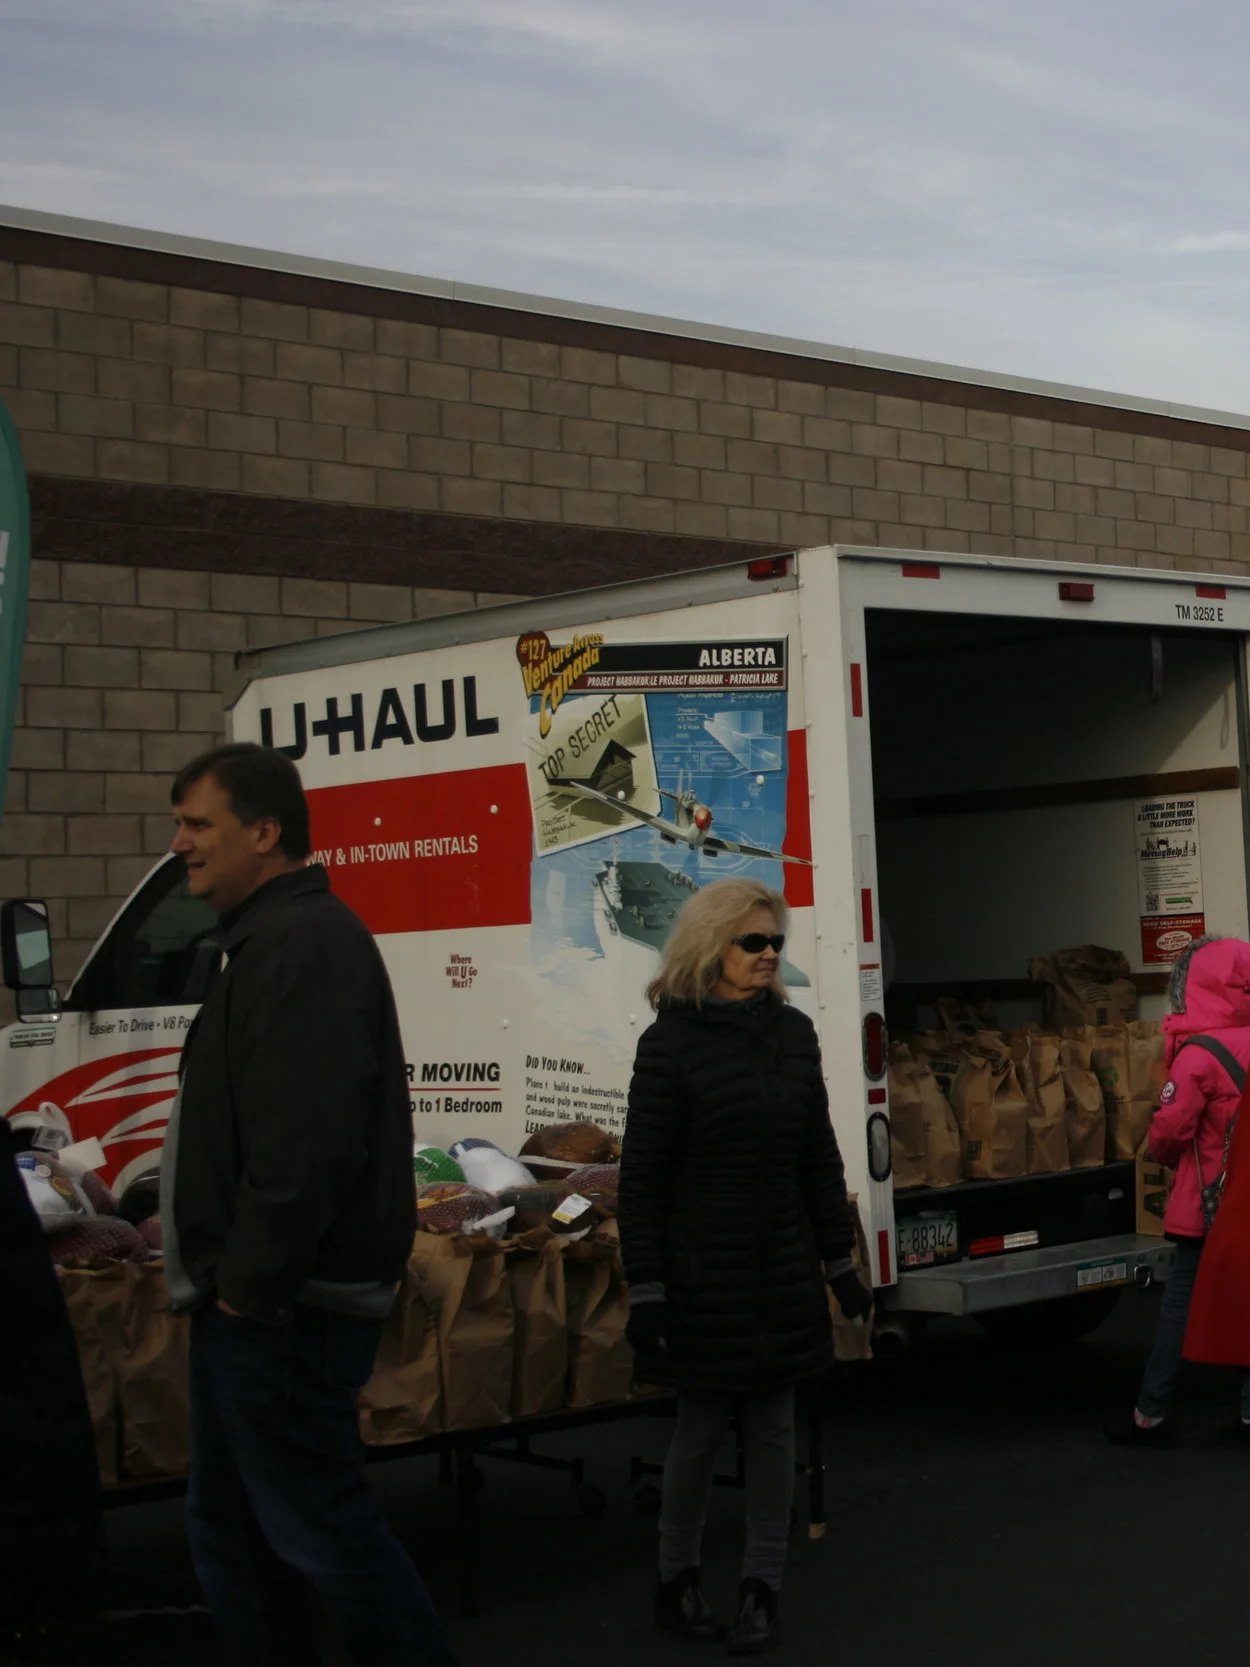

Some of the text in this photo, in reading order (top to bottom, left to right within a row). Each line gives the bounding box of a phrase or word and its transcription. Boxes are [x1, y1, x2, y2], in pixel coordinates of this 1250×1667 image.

[1175, 604, 1224, 622] TM 3252 E
[520, 639, 548, 661] #127
[699, 647, 777, 668] ALBERTA
[521, 643, 573, 699] Venture
[587, 675, 615, 688] PROJECT
[658, 674, 688, 686] PROJECT
[730, 673, 760, 685] PATRICIA
[761, 672, 778, 684] LAKE
[539, 646, 600, 739] Canada
[538, 747, 567, 782] TOP
[568, 694, 622, 759] SECRET
[1142, 812, 1160, 821] LITTLE
[1160, 810, 1176, 819] MORE
[1177, 809, 1194, 817] WORK
[1165, 802, 1176, 810] THE
[1177, 800, 1195, 809] TRUCK
[1149, 818, 1196, 829] THAN EXPECTED?
[336, 848, 346, 866] &
[350, 841, 411, 864] IN-TOWN
[414, 834, 479, 858] RENTALS
[450, 953, 473, 965] Where
[446, 965, 478, 979] Will U Go
[452, 977, 473, 989] Next?
[89, 1015, 194, 1036] Easier To Drive V8 Po
[405, 1062, 501, 1082] R MOVING
[525, 1055, 539, 1069] DID
[541, 1056, 558, 1071] YOU
[526, 1077, 543, 1089] Plans
[571, 1086, 579, 1094] an
[581, 1085, 625, 1100] indestructible
[420, 1097, 433, 1113] to
[444, 1097, 502, 1113] Bedroom
[525, 1092, 628, 1114] and wood pulp were secretly car
[525, 1104, 555, 1118] Canadian
[575, 1111, 593, 1123] What
[594, 1118, 607, 1126] was
[608, 1117, 619, 1127] the
